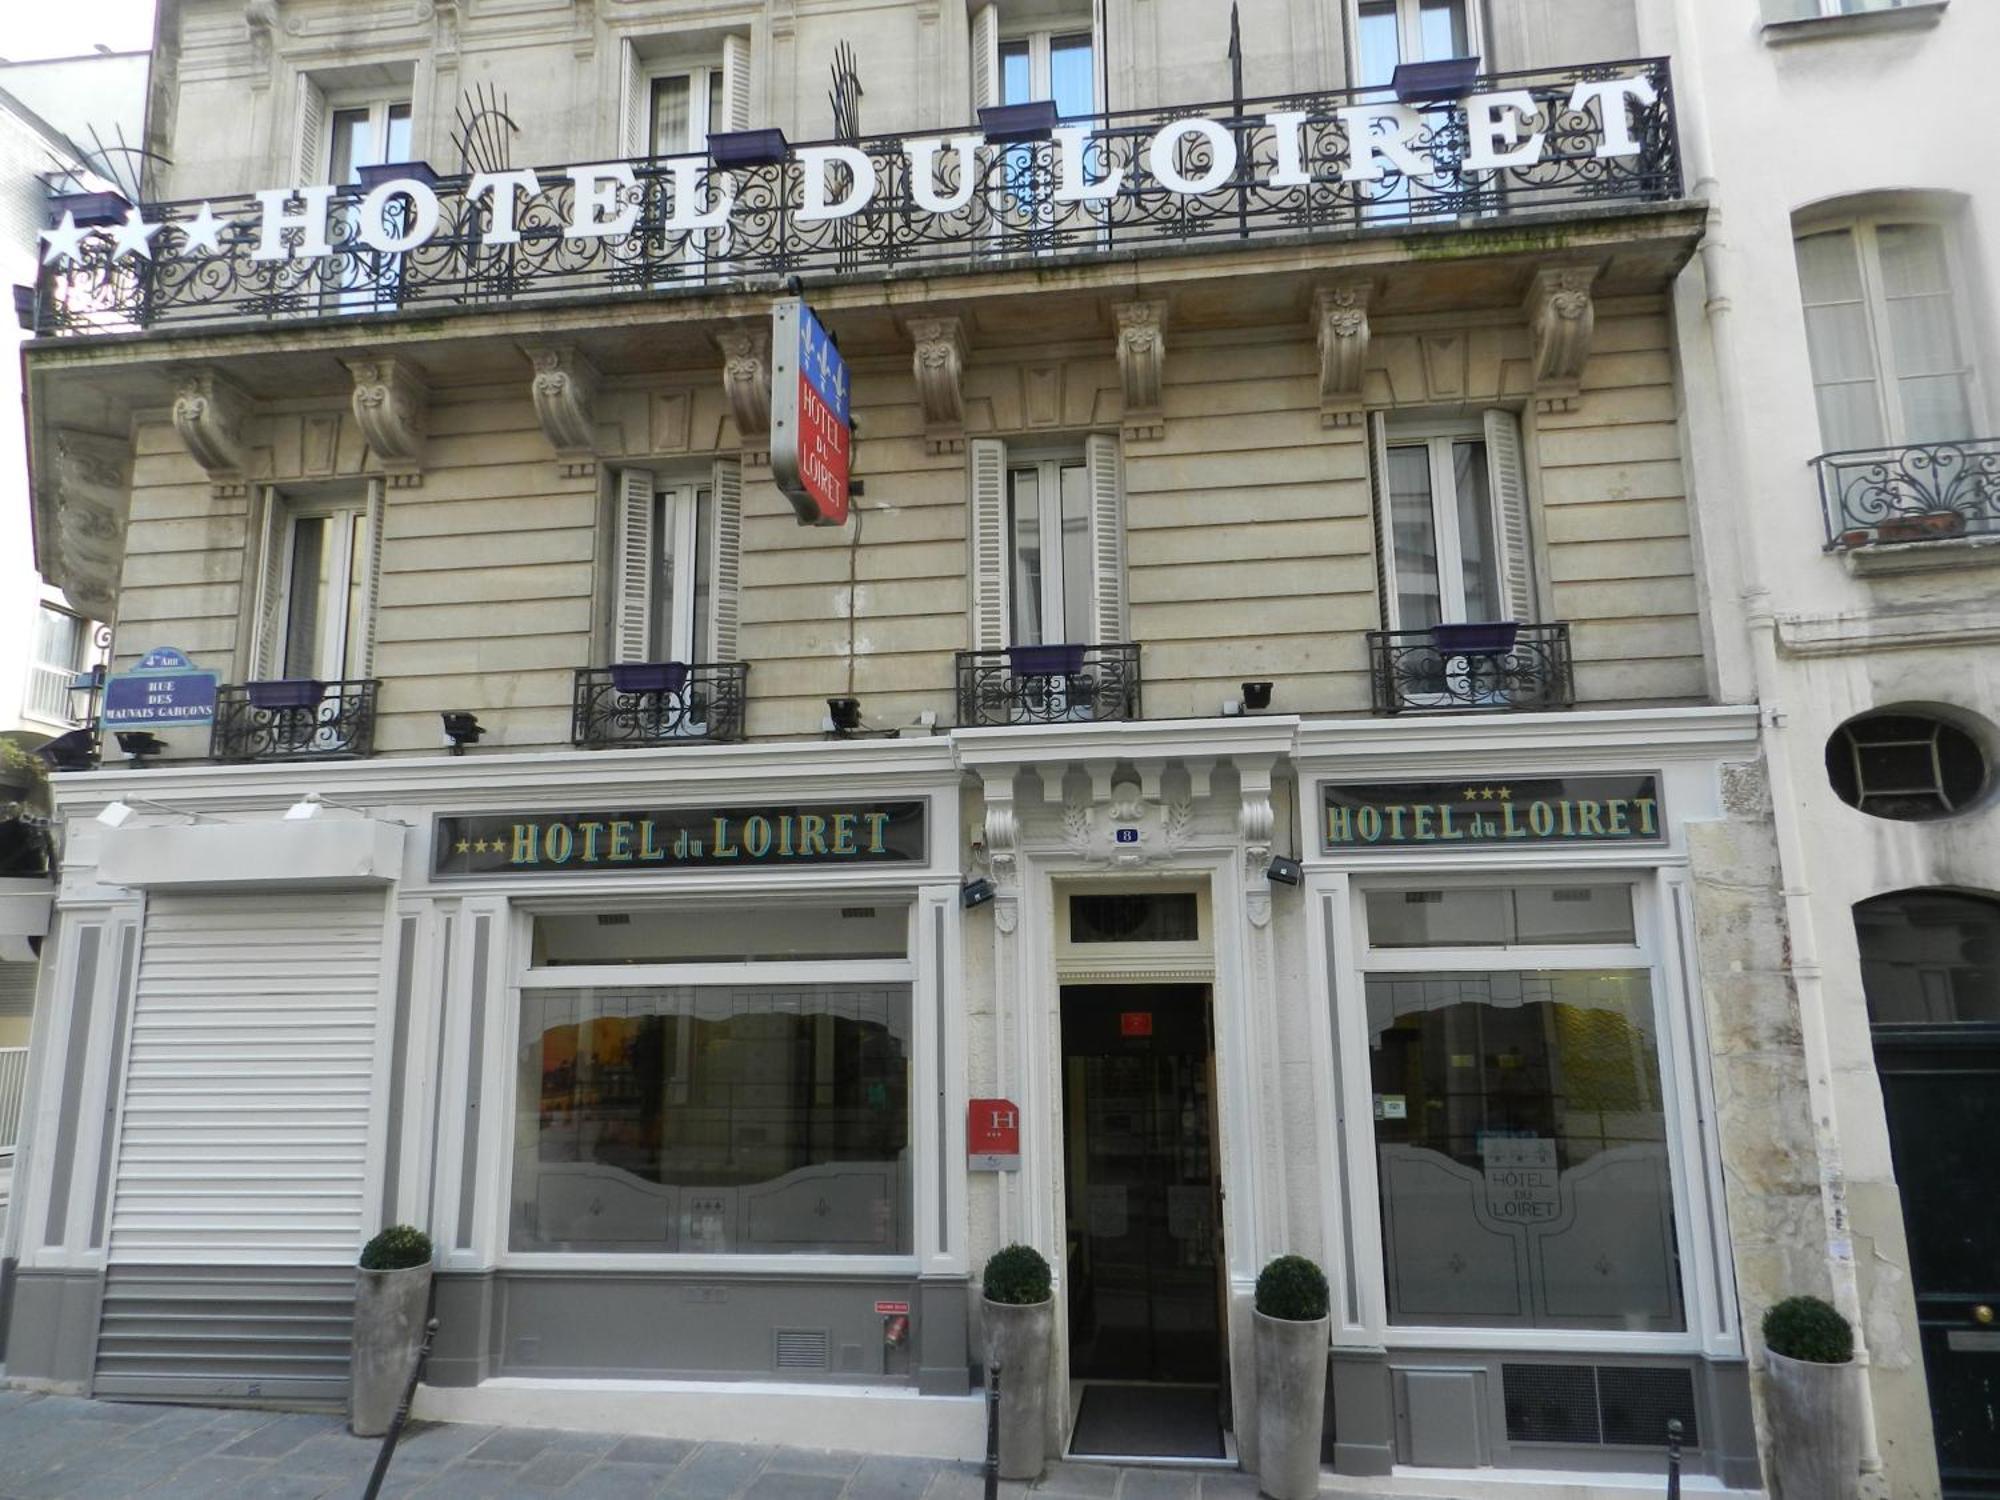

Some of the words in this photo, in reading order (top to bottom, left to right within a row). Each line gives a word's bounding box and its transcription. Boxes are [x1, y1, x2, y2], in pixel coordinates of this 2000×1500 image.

[250, 156, 735, 262] HOTEL
[794, 135, 982, 222] DU
[1049, 74, 1660, 201] LOIRET
[803, 382, 841, 454] HOTEL
[816, 436, 829, 460] DU
[802, 442, 841, 507] LOIRET
[148, 681, 175, 692] RUE
[148, 694, 172, 705] DES
[106, 707, 154, 720] MAUVAIS
[1328, 804, 1464, 843] HOTEL
[1470, 812, 1497, 839] du
[1501, 798, 1657, 837] LOIRET
[511, 819, 664, 865] HOTEL
[674, 828, 703, 860] du
[712, 812, 890, 858] LOIRET
[1123, 831, 1132, 842] 8
[991, 1111, 1015, 1129] H
[1493, 1202, 1556, 1217] LOIRET
